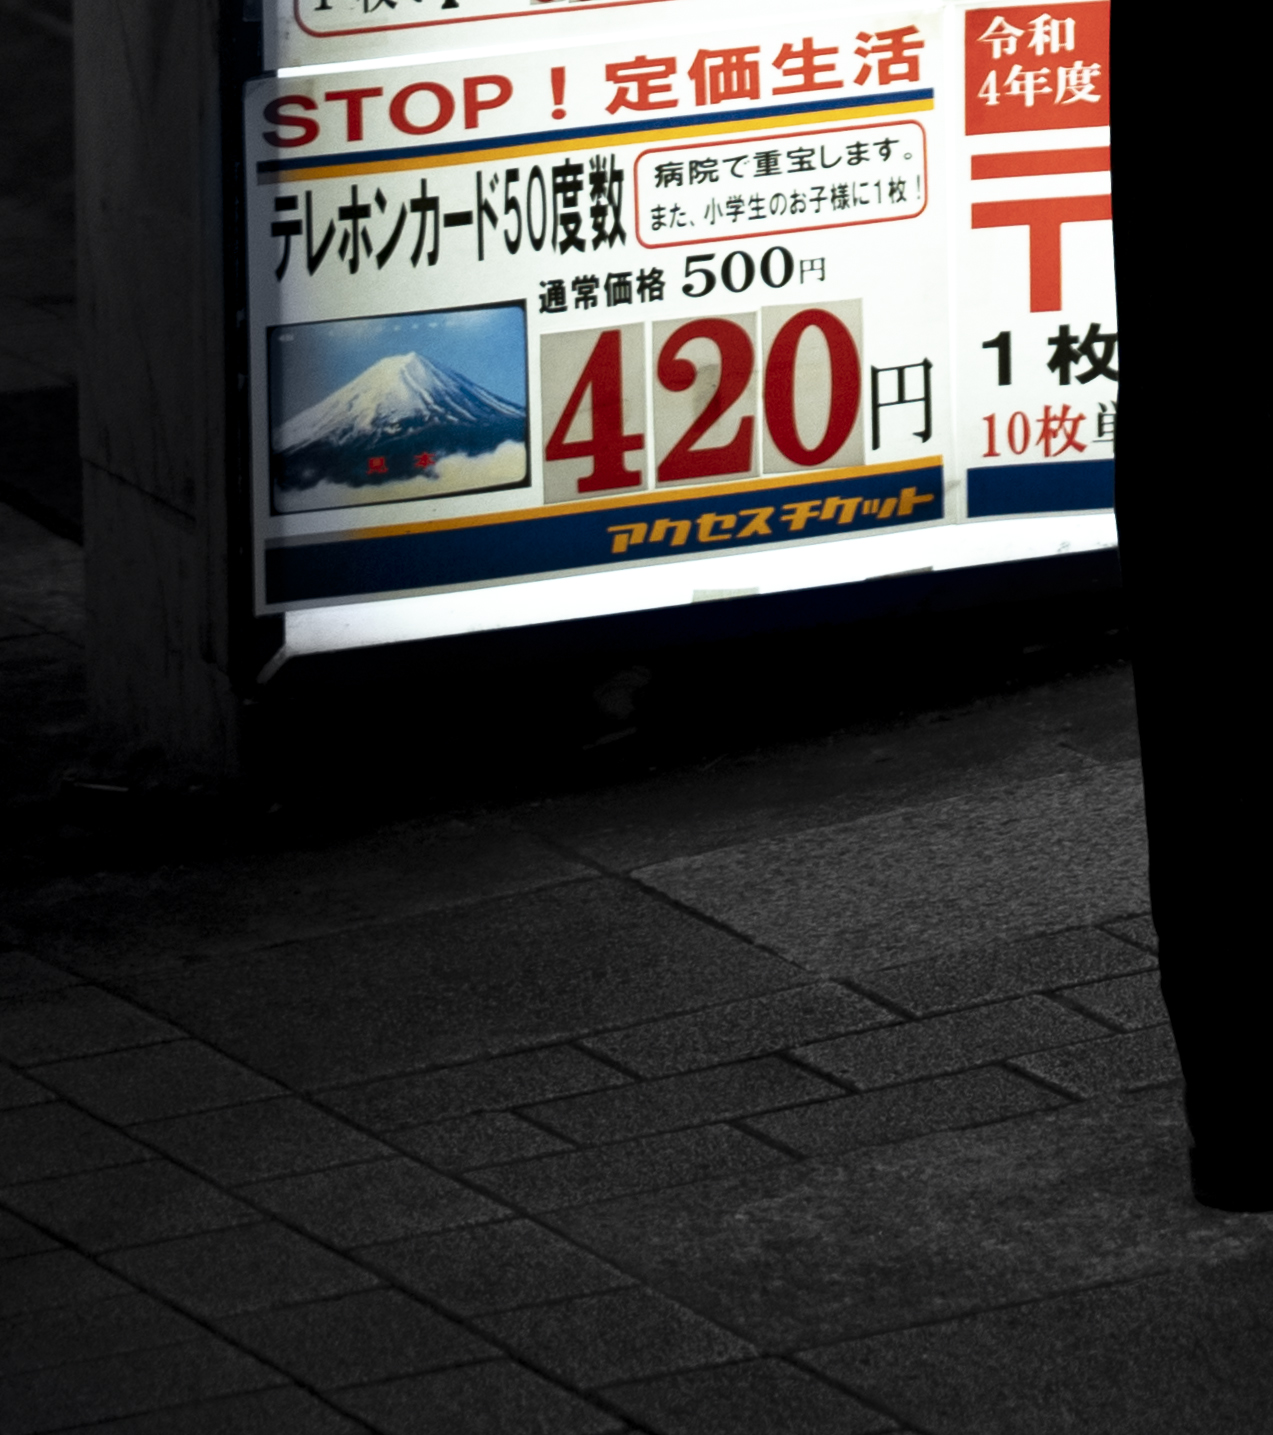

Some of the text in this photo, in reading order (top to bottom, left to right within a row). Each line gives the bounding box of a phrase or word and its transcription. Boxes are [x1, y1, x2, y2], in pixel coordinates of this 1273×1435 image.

[604, 24, 926, 116] 定価生活
[977, 14, 1076, 59] 令和
[977, 62, 1103, 108] 4年度
[653, 136, 915, 191] 病院で重宝します。
[269, 153, 628, 284] テレホンカード50度数
[538, 243, 828, 315] 通常価格 500円
[607, 486, 935, 555] アクセスチケット
